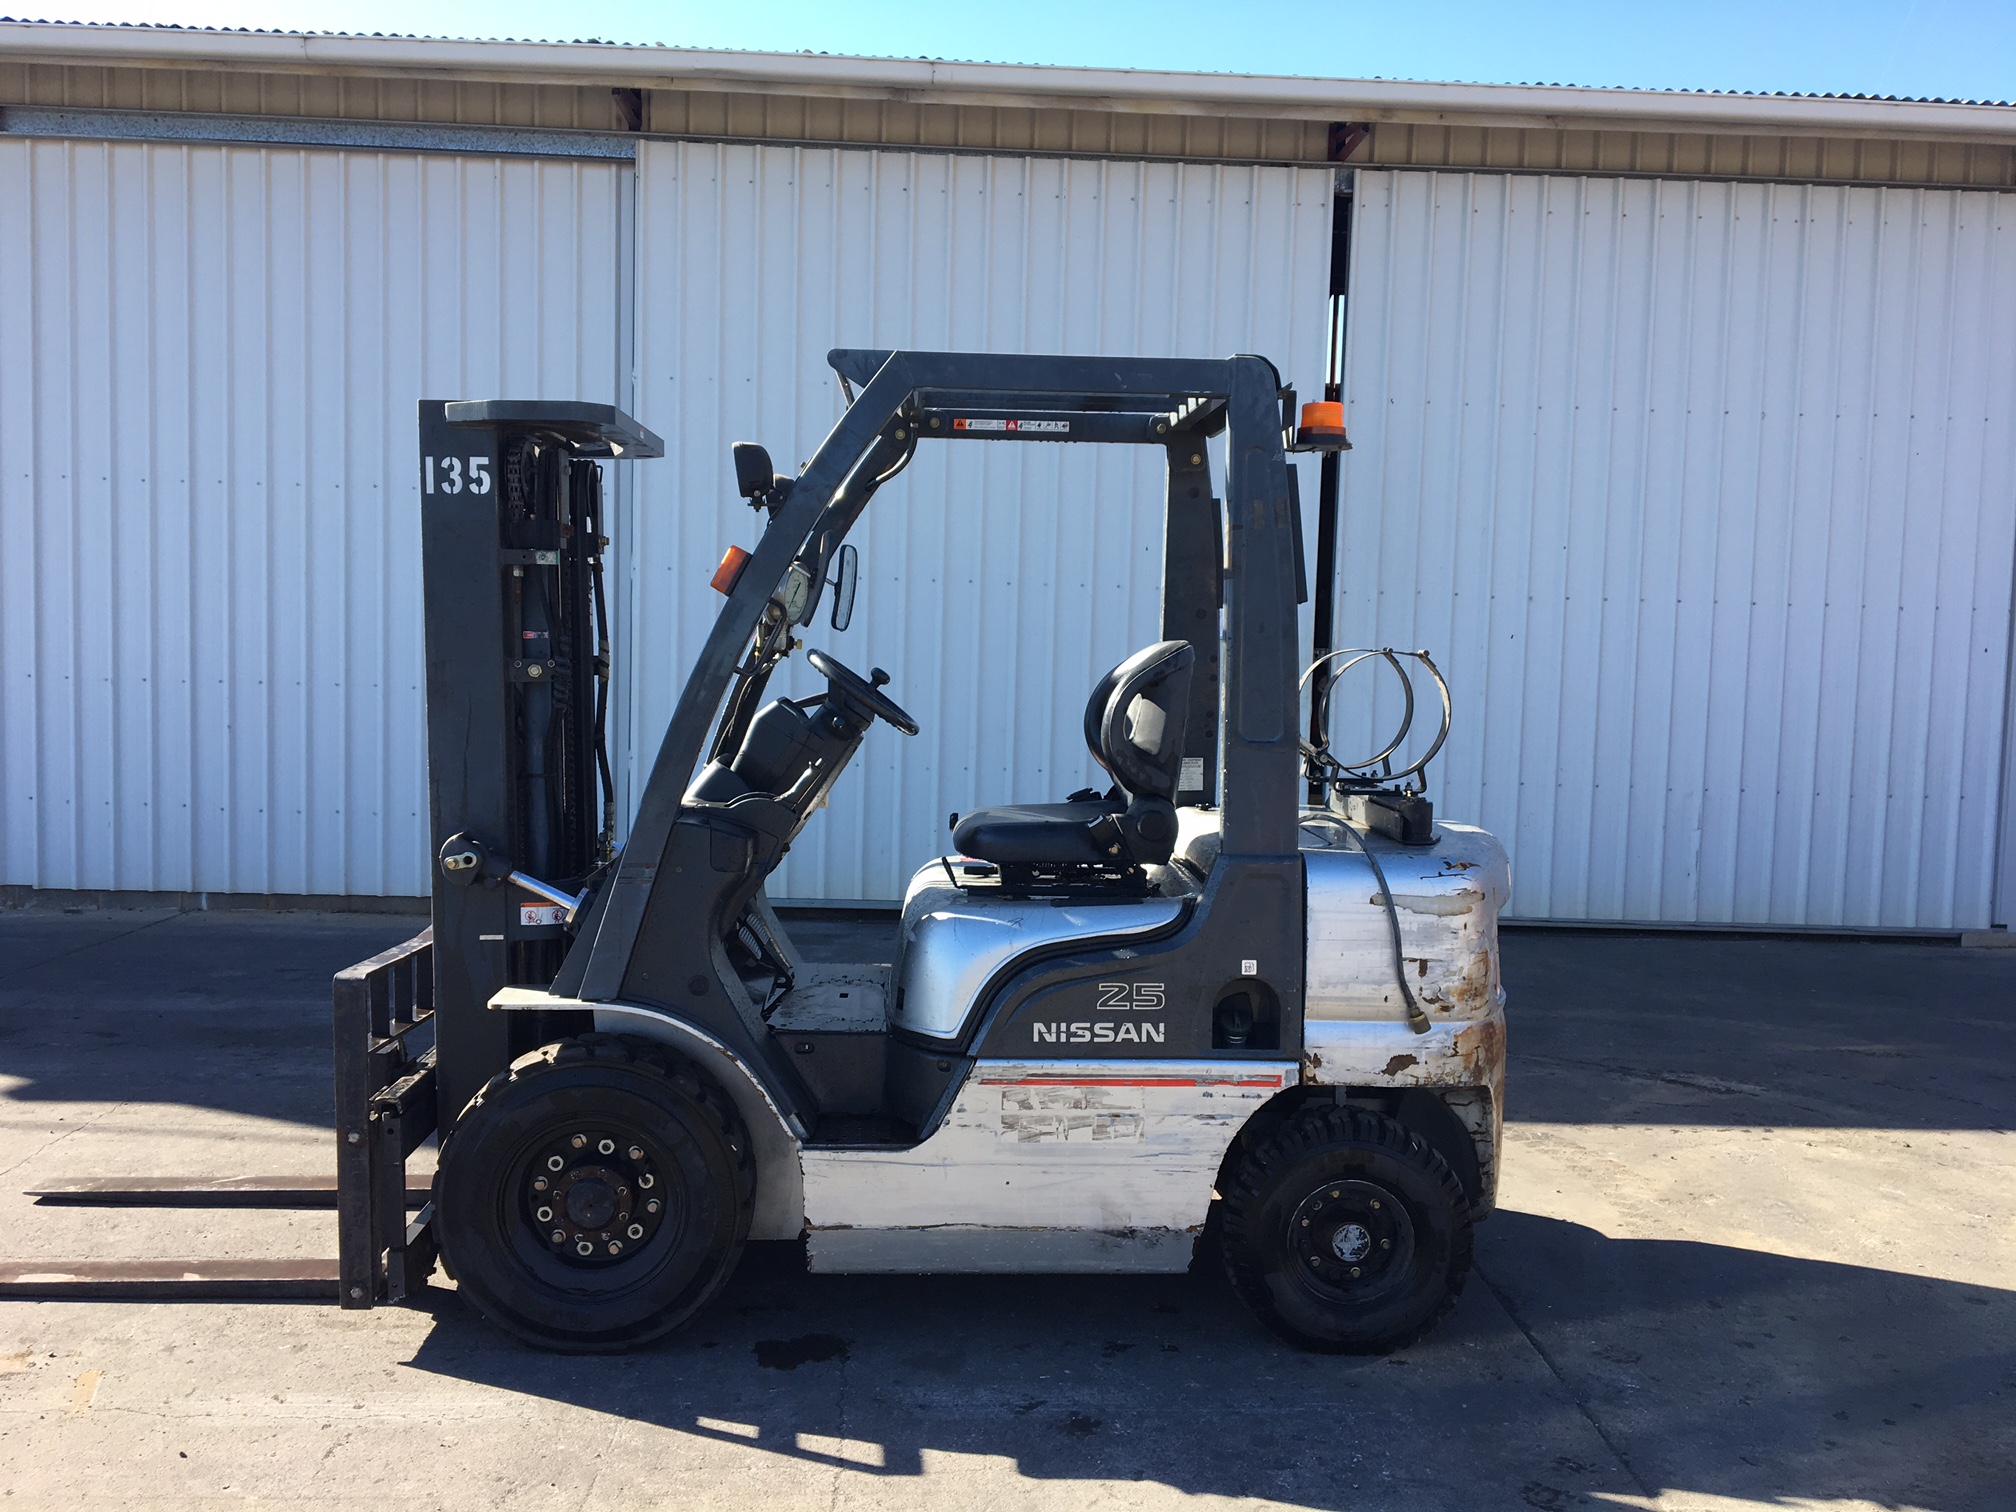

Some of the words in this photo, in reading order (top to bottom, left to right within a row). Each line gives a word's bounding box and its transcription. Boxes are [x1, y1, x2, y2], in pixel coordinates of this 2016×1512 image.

[425, 456, 491, 494] 135
[1096, 982, 1166, 1010] 25
[1033, 1022, 1165, 1043] NISSAN
